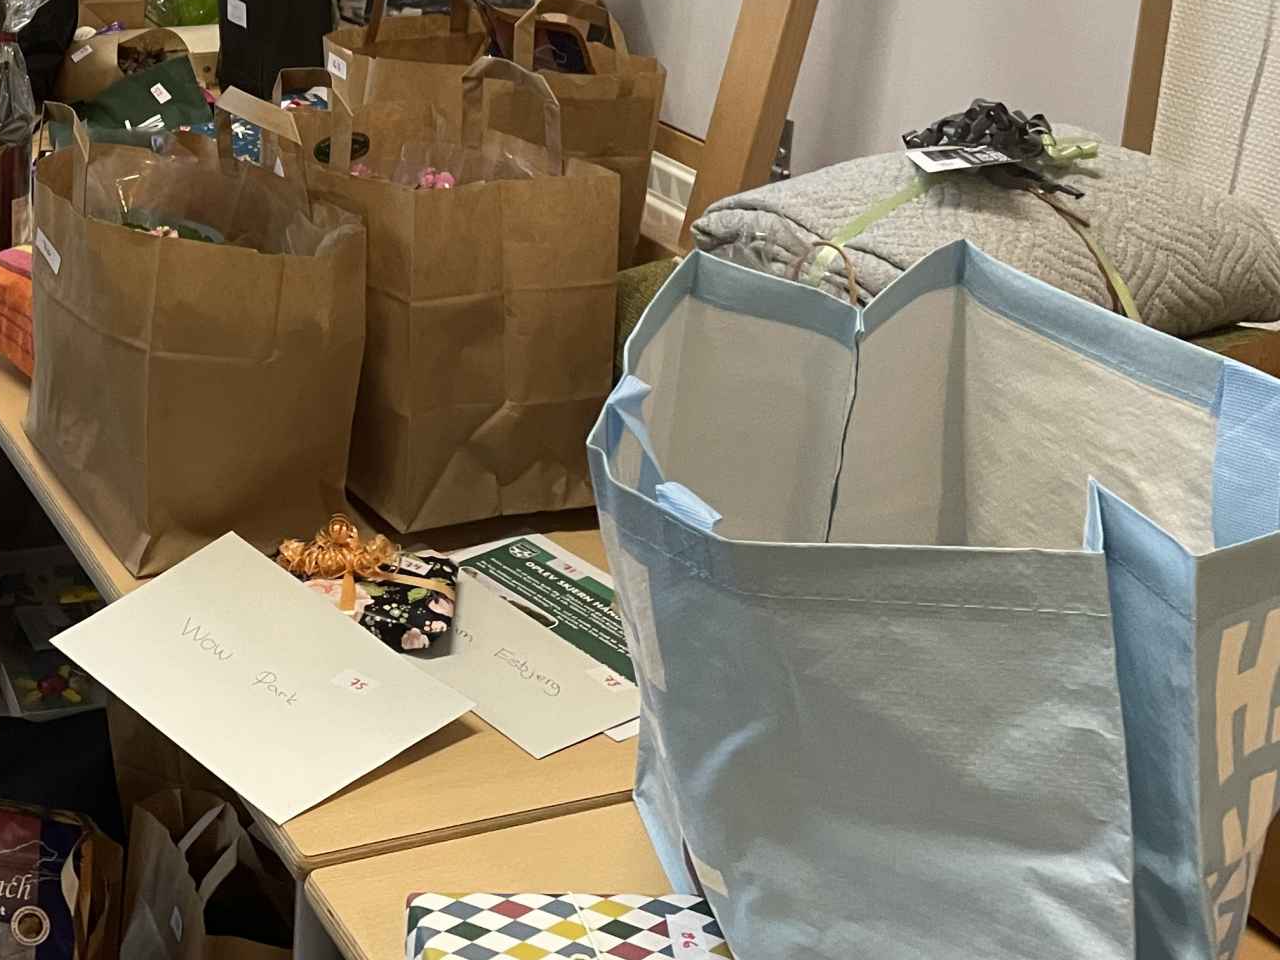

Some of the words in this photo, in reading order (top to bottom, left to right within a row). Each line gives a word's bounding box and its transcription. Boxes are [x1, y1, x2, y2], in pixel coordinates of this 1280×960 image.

[525, 561, 558, 580] OPLEV
[557, 580, 595, 603] SKJERN
[252, 671, 297, 705] Park
[493, 648, 561, 697] Esbjerg
